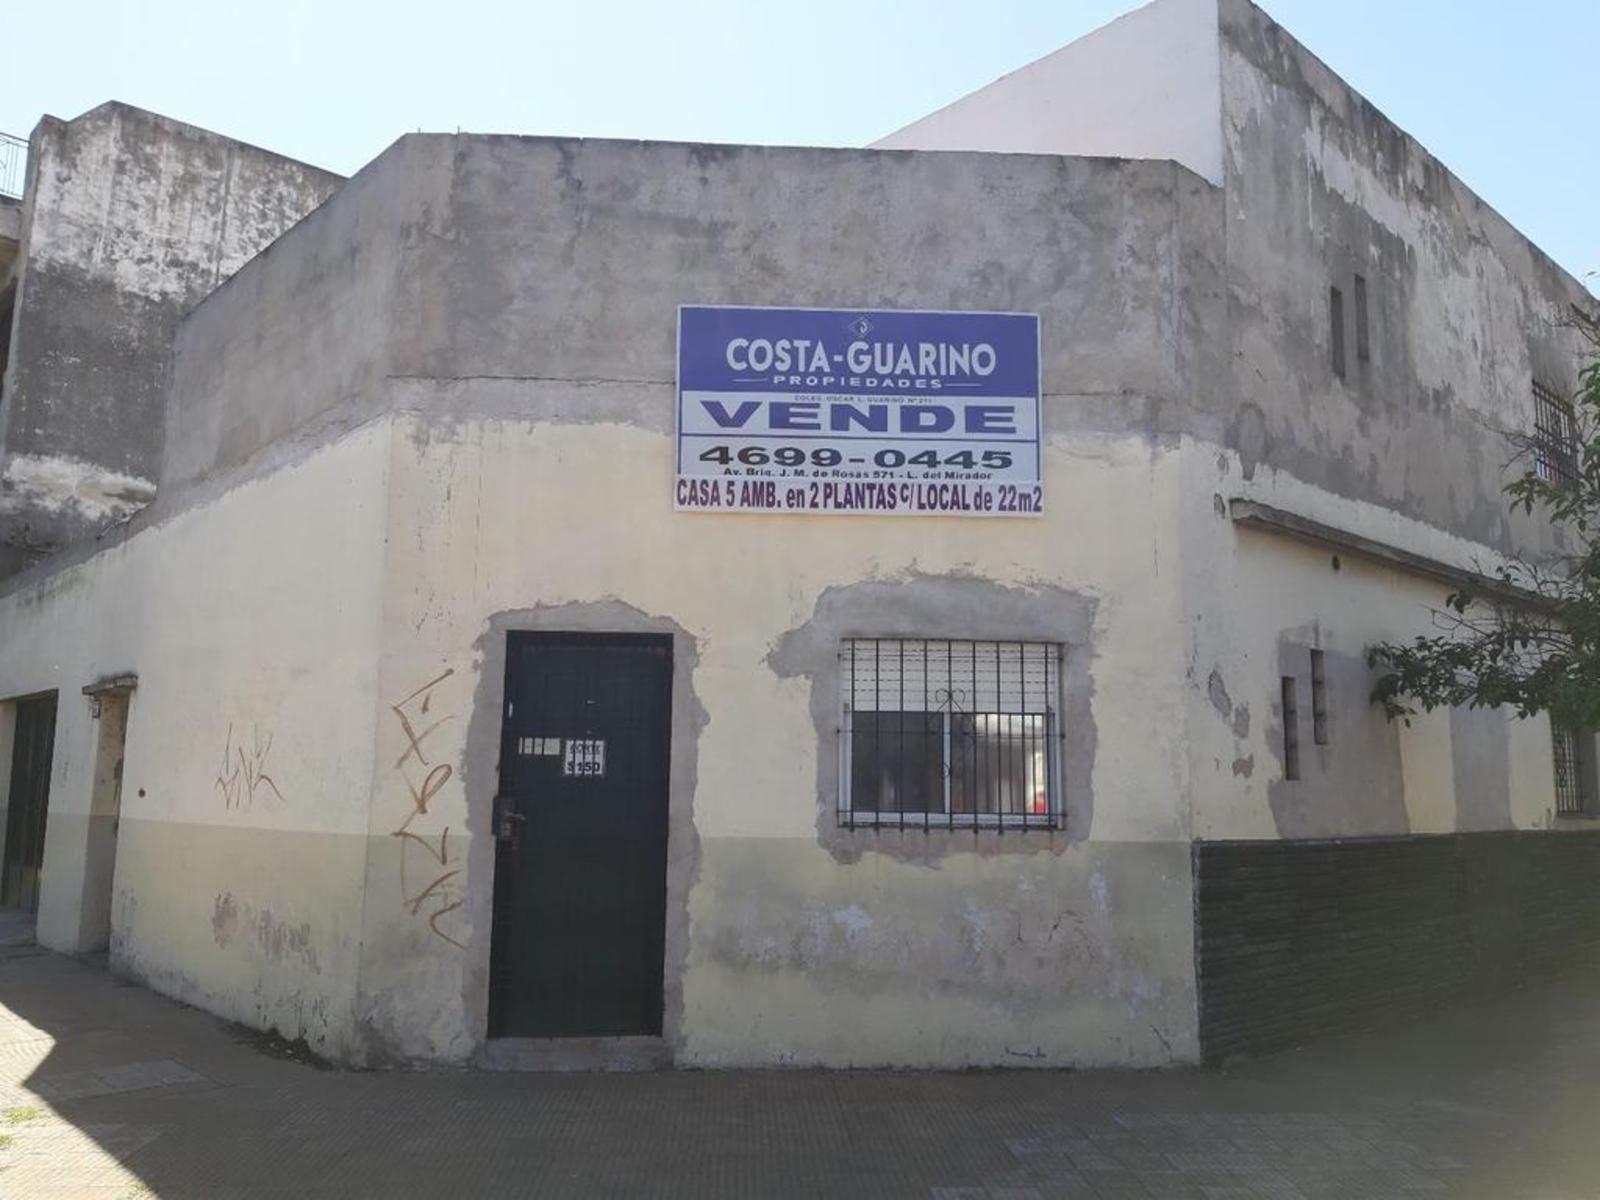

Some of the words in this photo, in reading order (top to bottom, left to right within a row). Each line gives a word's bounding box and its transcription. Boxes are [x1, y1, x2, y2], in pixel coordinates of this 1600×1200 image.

[726, 338, 997, 376] COSTA-GUARINO
[773, 376, 941, 388] PROPIEDADES
[700, 400, 1017, 434] VENDE
[699, 446, 1013, 469] 4699-0445
[724, 467, 742, 477] Av.
[746, 467, 776, 479] Brig.
[779, 469, 789, 478] J.
[794, 469, 808, 478] M.
[812, 469, 828, 479] de
[832, 471, 869, 480] Rosas
[873, 471, 894, 480] 571
[907, 471, 918, 480] L.
[922, 472, 941, 481] del
[944, 472, 993, 481] Mirador
[676, 479, 721, 507] CASA
[726, 481, 735, 507] 5
[740, 481, 782, 508] AMB.
[786, 487, 805, 508] en
[809, 482, 819, 509] 2
[823, 482, 897, 510] PLANTAS
[917, 484, 971, 511] LOCAL
[974, 485, 993, 511] de
[998, 485, 1042, 513] 22m2
